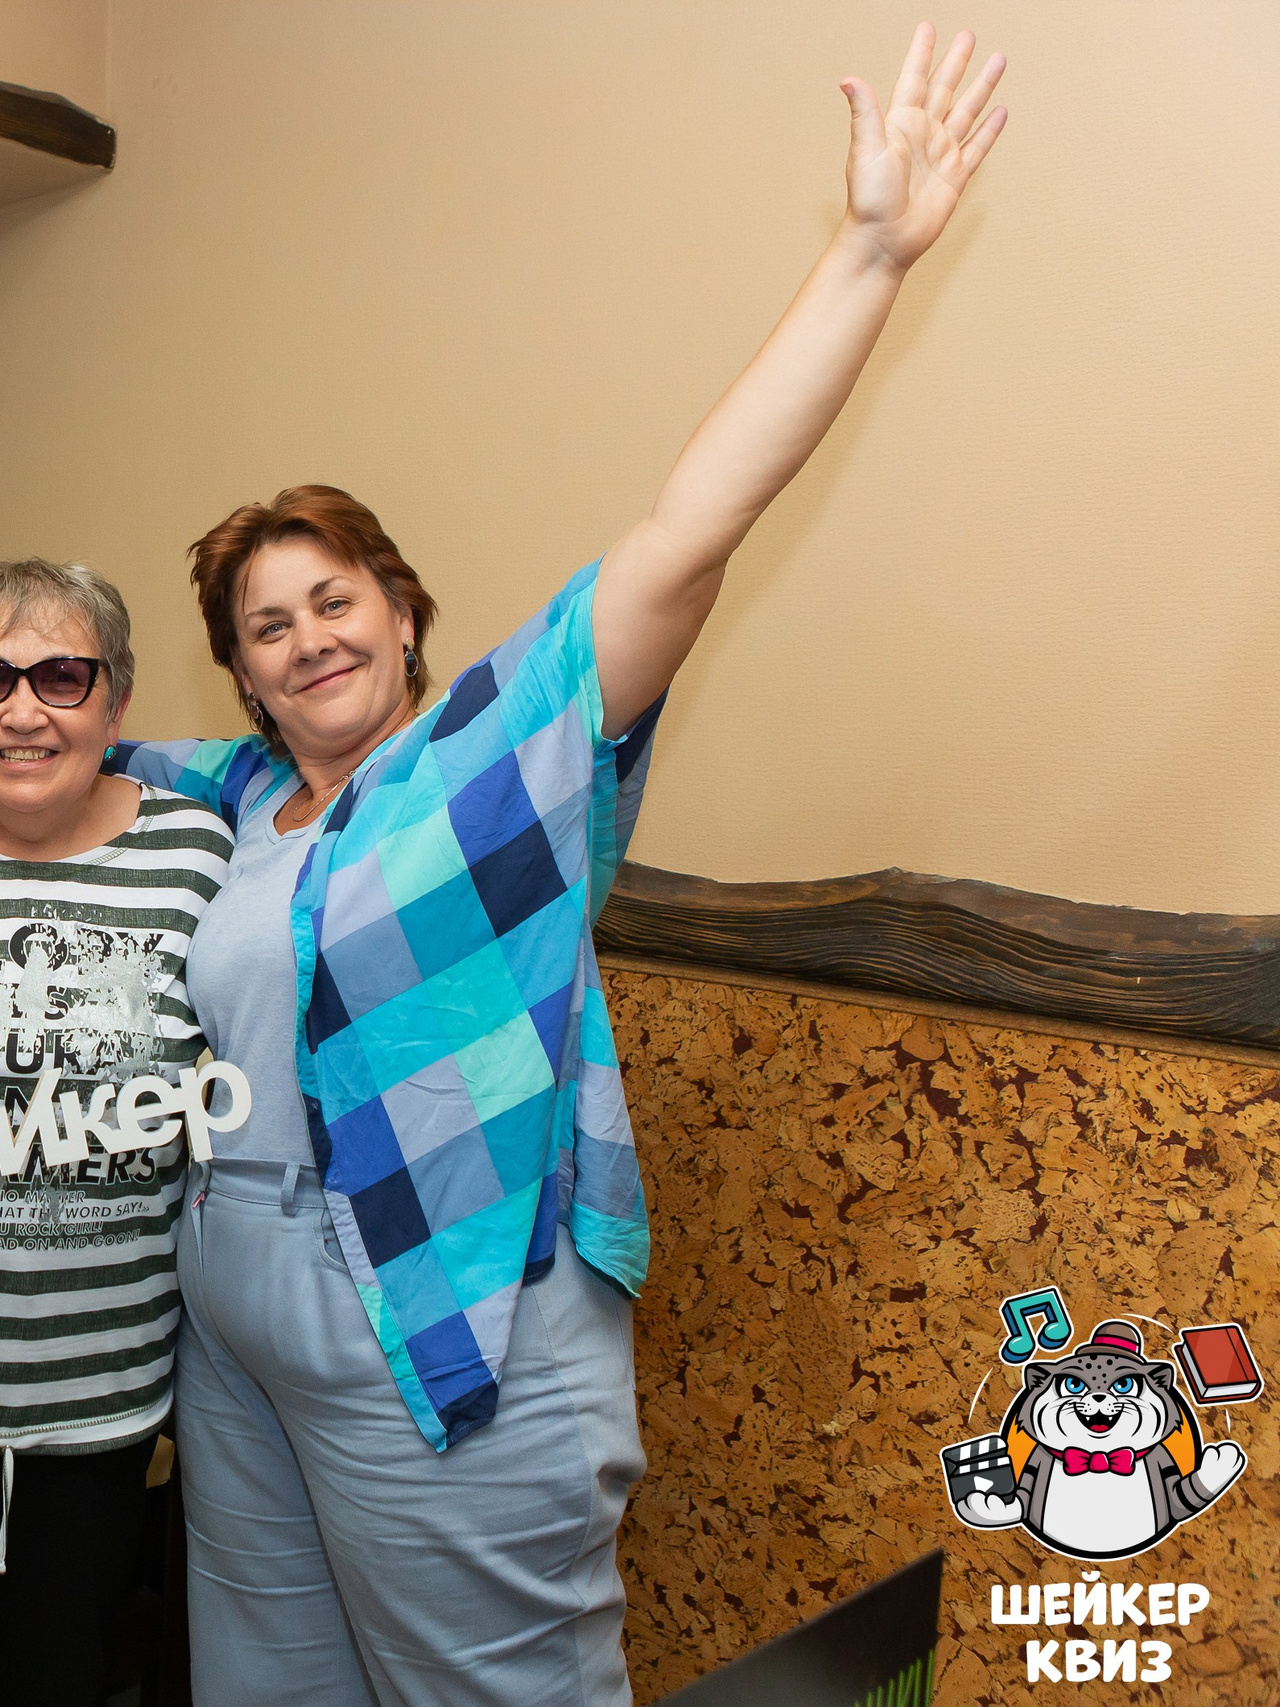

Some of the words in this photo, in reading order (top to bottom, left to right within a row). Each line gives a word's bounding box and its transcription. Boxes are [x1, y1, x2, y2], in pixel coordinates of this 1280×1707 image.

[65, 1206, 112, 1219] WORD
[14, 1221, 61, 1237] ROCK
[64, 1219, 104, 1236] GIRL!
[23, 1237, 51, 1252] ON
[54, 1236, 89, 1251] AND
[92, 1227, 141, 1249] GOON!
